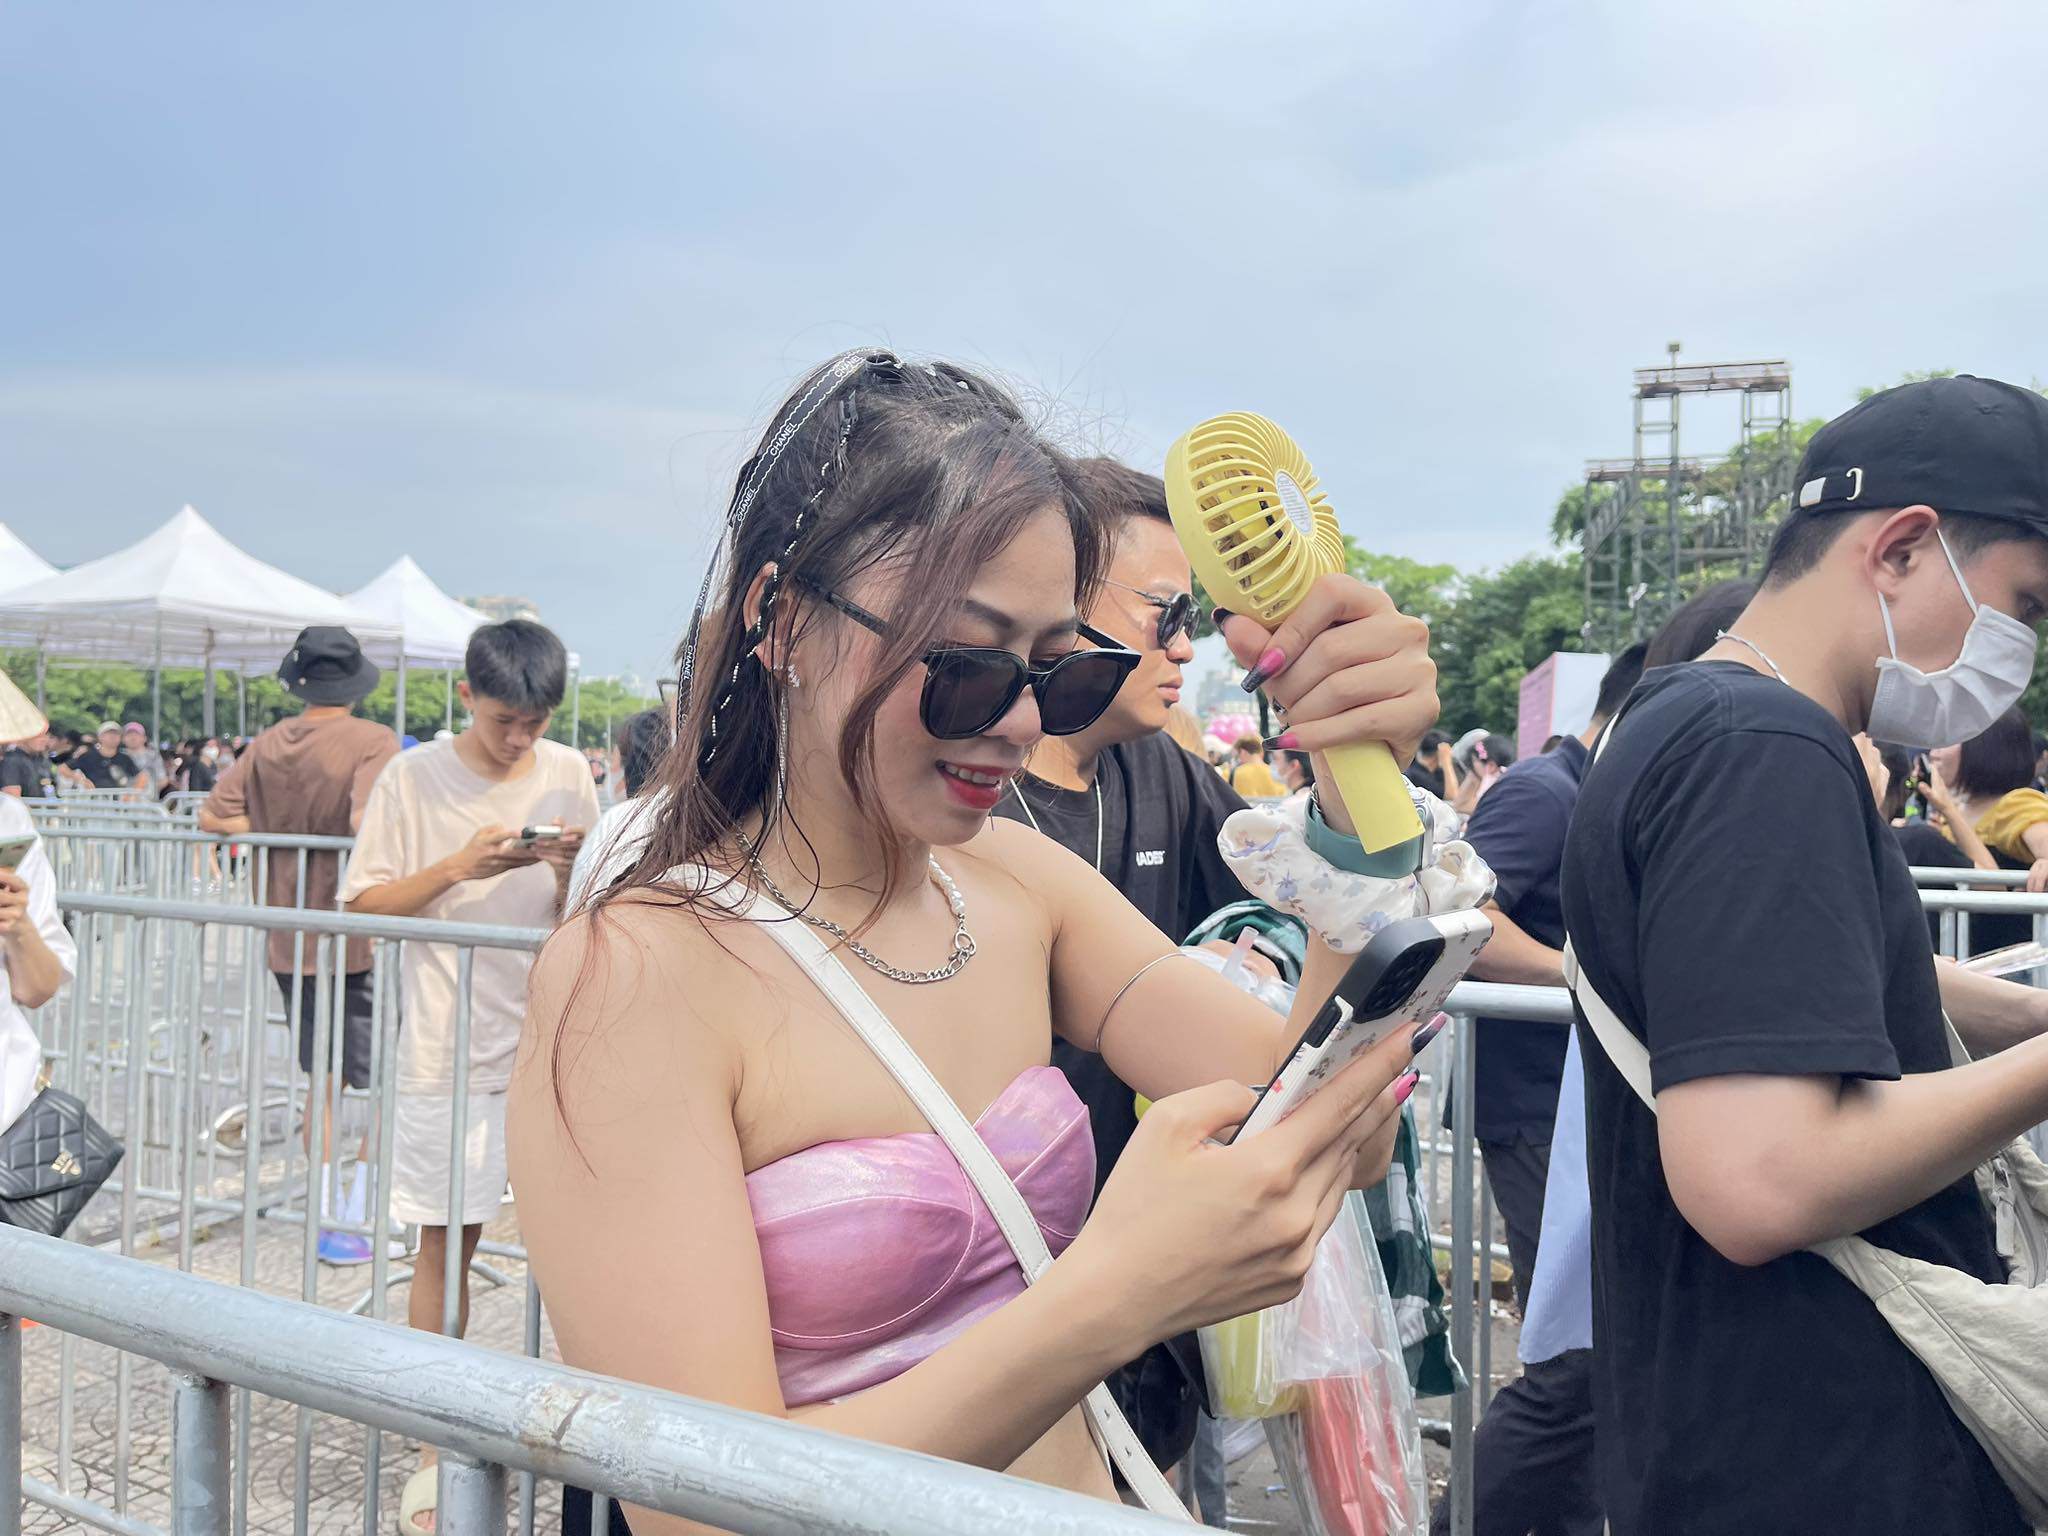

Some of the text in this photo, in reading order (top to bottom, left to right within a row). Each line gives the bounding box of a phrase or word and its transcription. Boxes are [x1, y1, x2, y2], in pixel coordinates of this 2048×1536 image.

[770, 422, 798, 456] CHANEL
[737, 488, 756, 522] CHANEL
[684, 645, 694, 681] CHANEL
